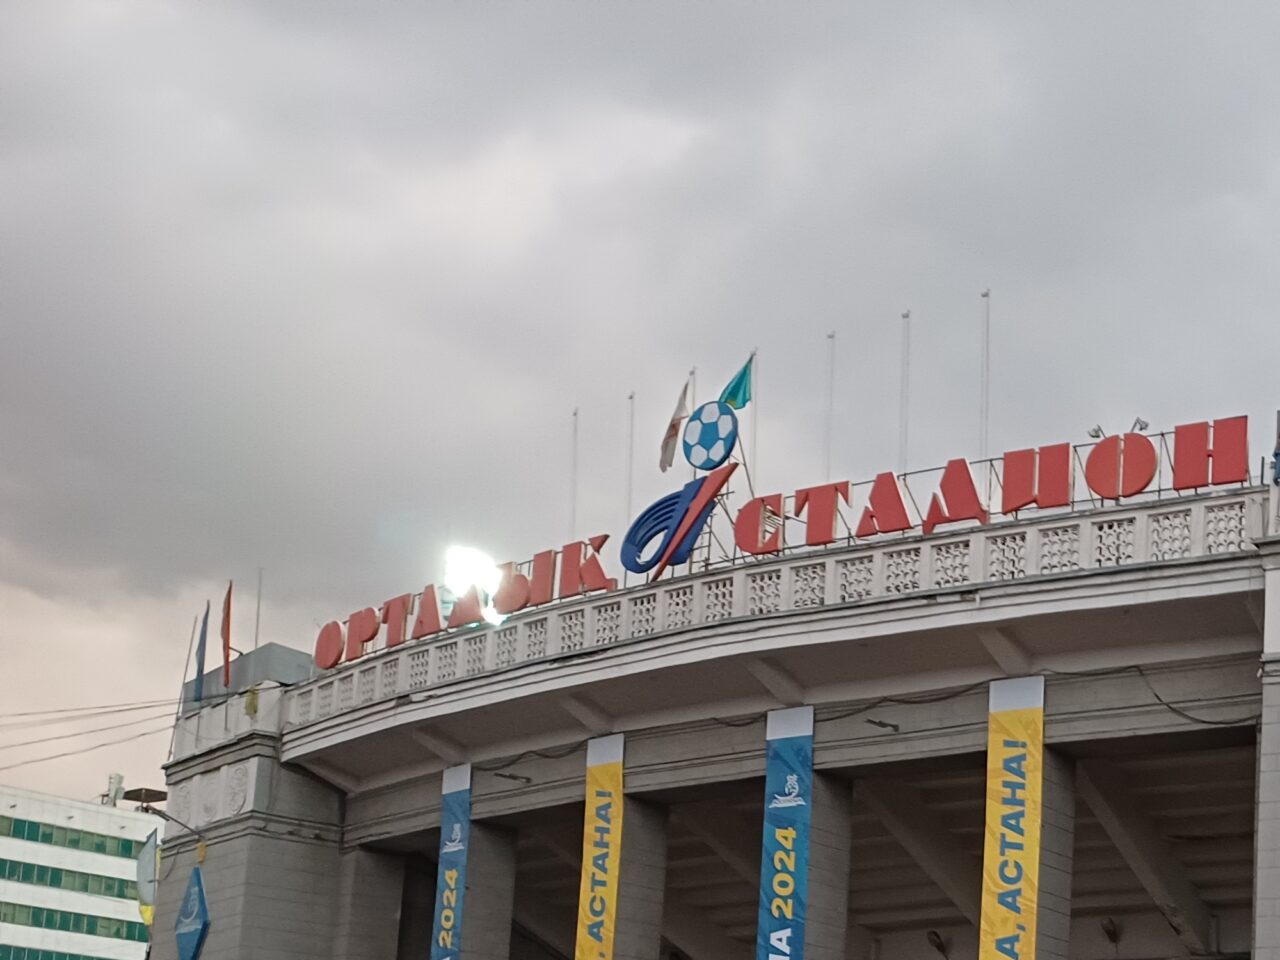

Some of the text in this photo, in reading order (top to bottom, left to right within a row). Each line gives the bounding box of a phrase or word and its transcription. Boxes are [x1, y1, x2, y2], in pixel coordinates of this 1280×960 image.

[734, 415, 1248, 554] СТАДИОН
[587, 790, 613, 942] АСТАНА!
[771, 827, 797, 920] 2024
[997, 739, 1028, 914] АСТАНА!
[438, 869, 458, 949] 2024
